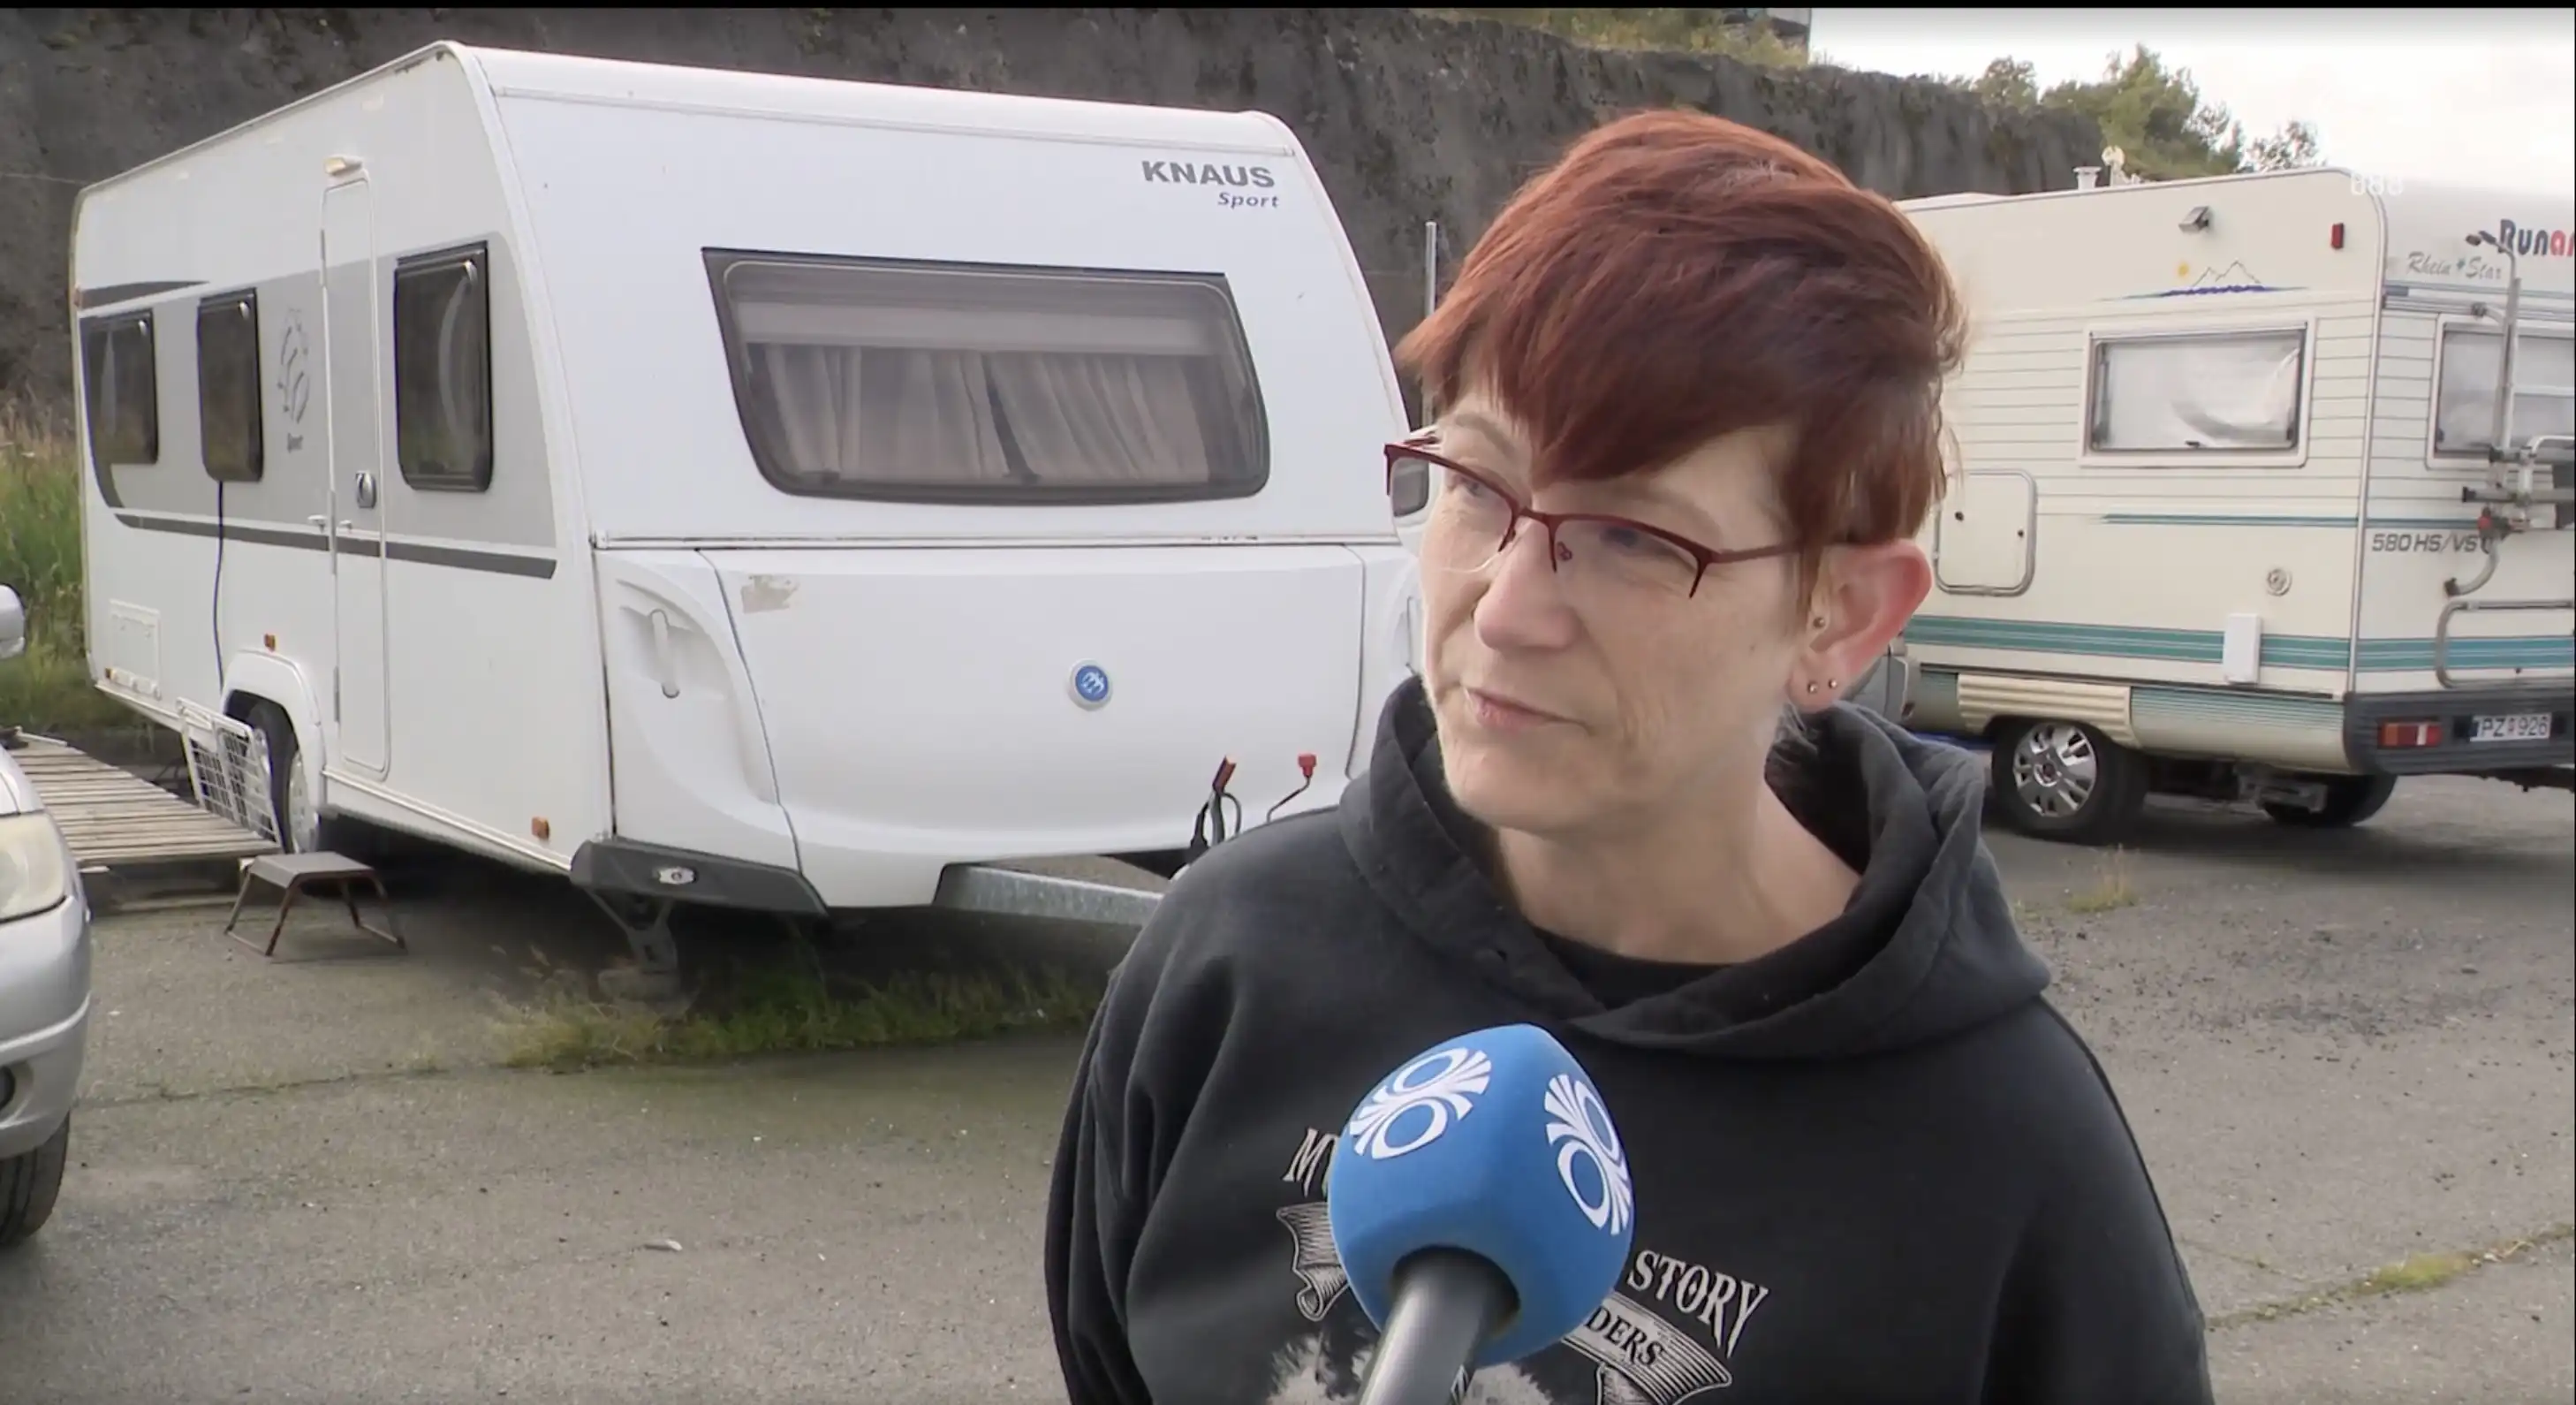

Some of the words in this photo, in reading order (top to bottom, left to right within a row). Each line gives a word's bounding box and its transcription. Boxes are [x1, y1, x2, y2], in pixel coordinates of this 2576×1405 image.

[1141, 160, 1275, 188] KNAUS
[1217, 191, 1279, 209] Sport
[2372, 533, 2412, 552] 580
[1627, 1249, 1769, 1360] STORY
